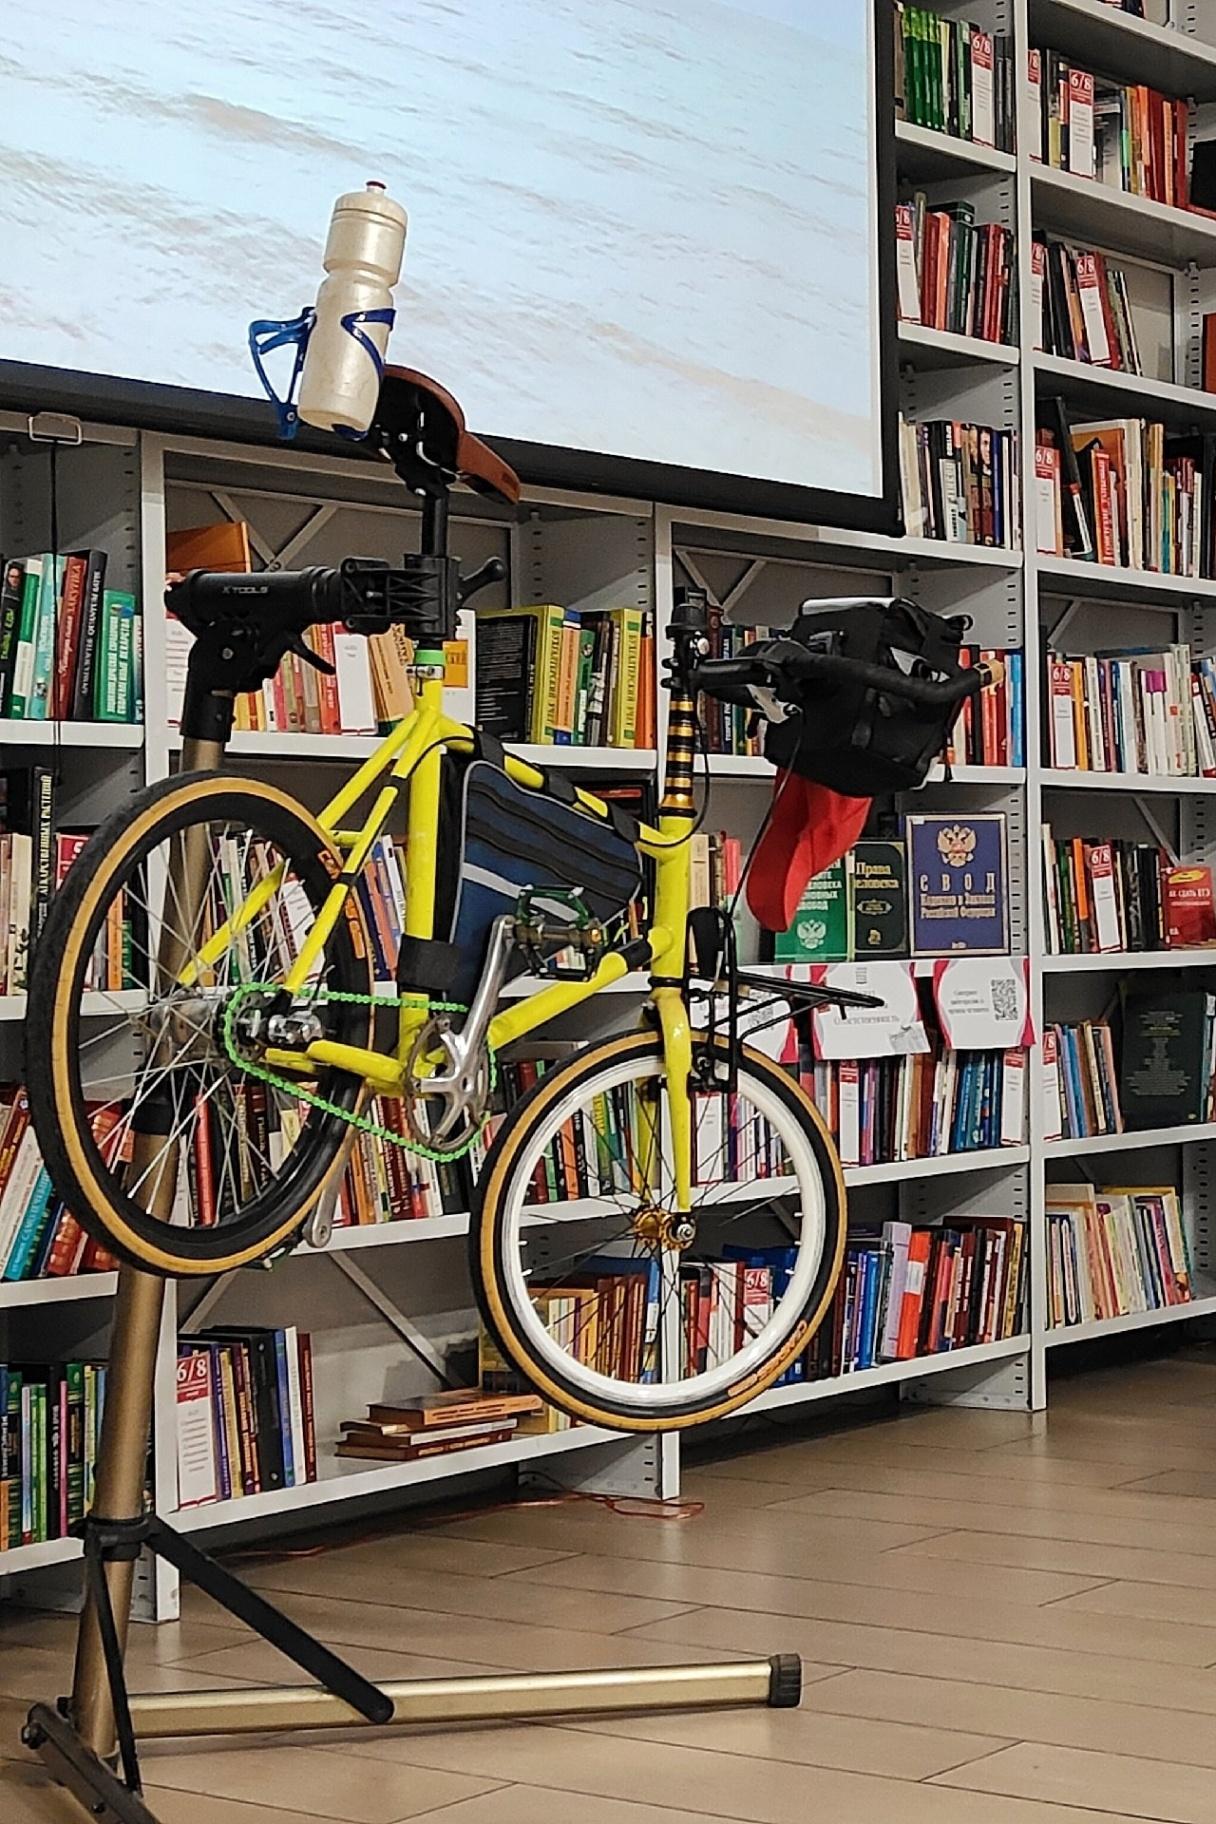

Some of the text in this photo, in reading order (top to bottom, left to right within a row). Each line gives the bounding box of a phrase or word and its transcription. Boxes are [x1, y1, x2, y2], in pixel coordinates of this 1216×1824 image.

[973, 35, 991, 54] 6/8
[1071, 72, 1092, 90] 6/8
[1077, 256, 1096, 273] 6/8
[1036, 448, 1055, 465] 6/8
[548, 630, 561, 699] БУХГАЛТЕРСКИЙ
[627, 634, 640, 702] БУХГАЛТЕРСКИЙ
[1053, 664, 1071, 681] 6/8
[1091, 848, 1111, 866] 6/8
[856, 862, 892, 879] Права
[176, 1357, 208, 1382] 6/8
